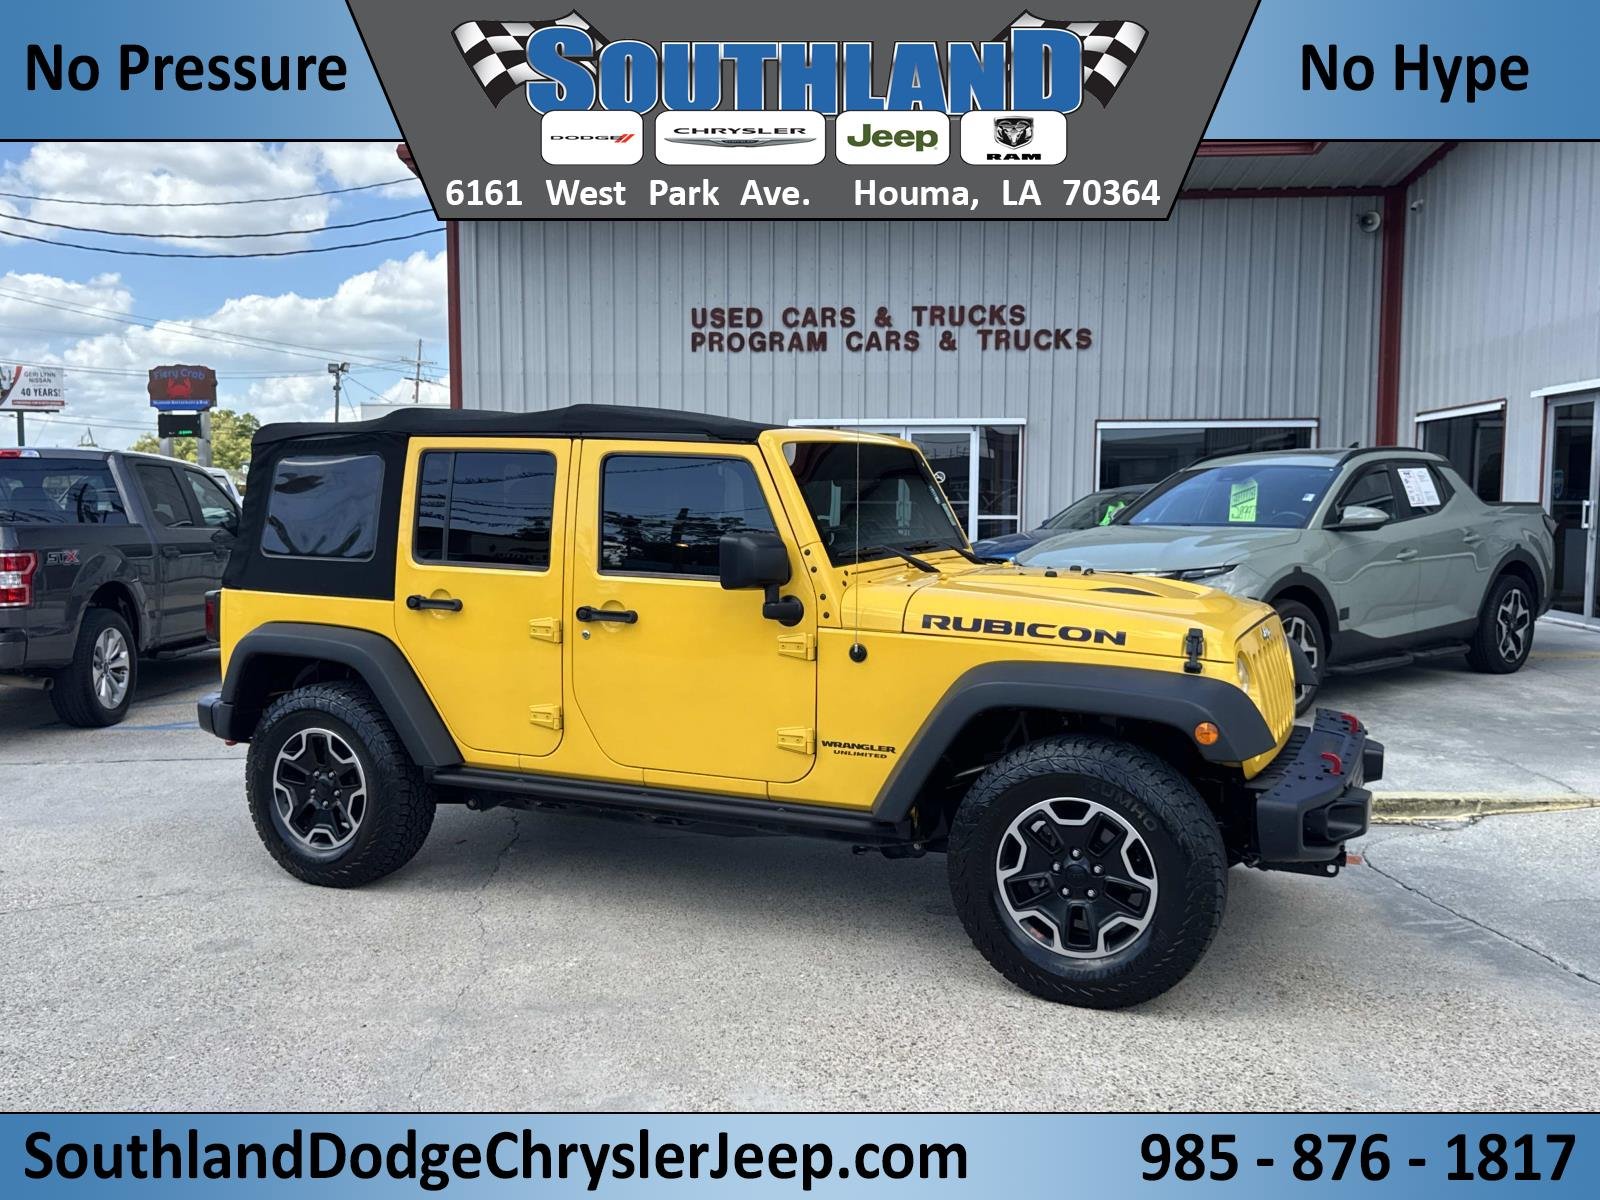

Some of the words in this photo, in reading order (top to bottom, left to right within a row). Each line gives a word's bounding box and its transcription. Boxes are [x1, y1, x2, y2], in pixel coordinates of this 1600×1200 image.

[691, 307, 763, 329] USED
[782, 306, 856, 329] CARS
[874, 306, 893, 328] &
[911, 304, 1026, 328] TRUCKS
[691, 331, 828, 352] PROGRAM
[845, 330, 920, 352] CARS
[939, 330, 957, 352] &
[976, 328, 1092, 351] TRUCKS
[20, 387, 31, 397] 40
[33, 387, 62, 398] YEARS!
[47, 550, 80, 566] STX
[922, 614, 1127, 646] RUBICON
[821, 740, 896, 754] WRANGLER
[833, 749, 888, 759] UNLIMITED
